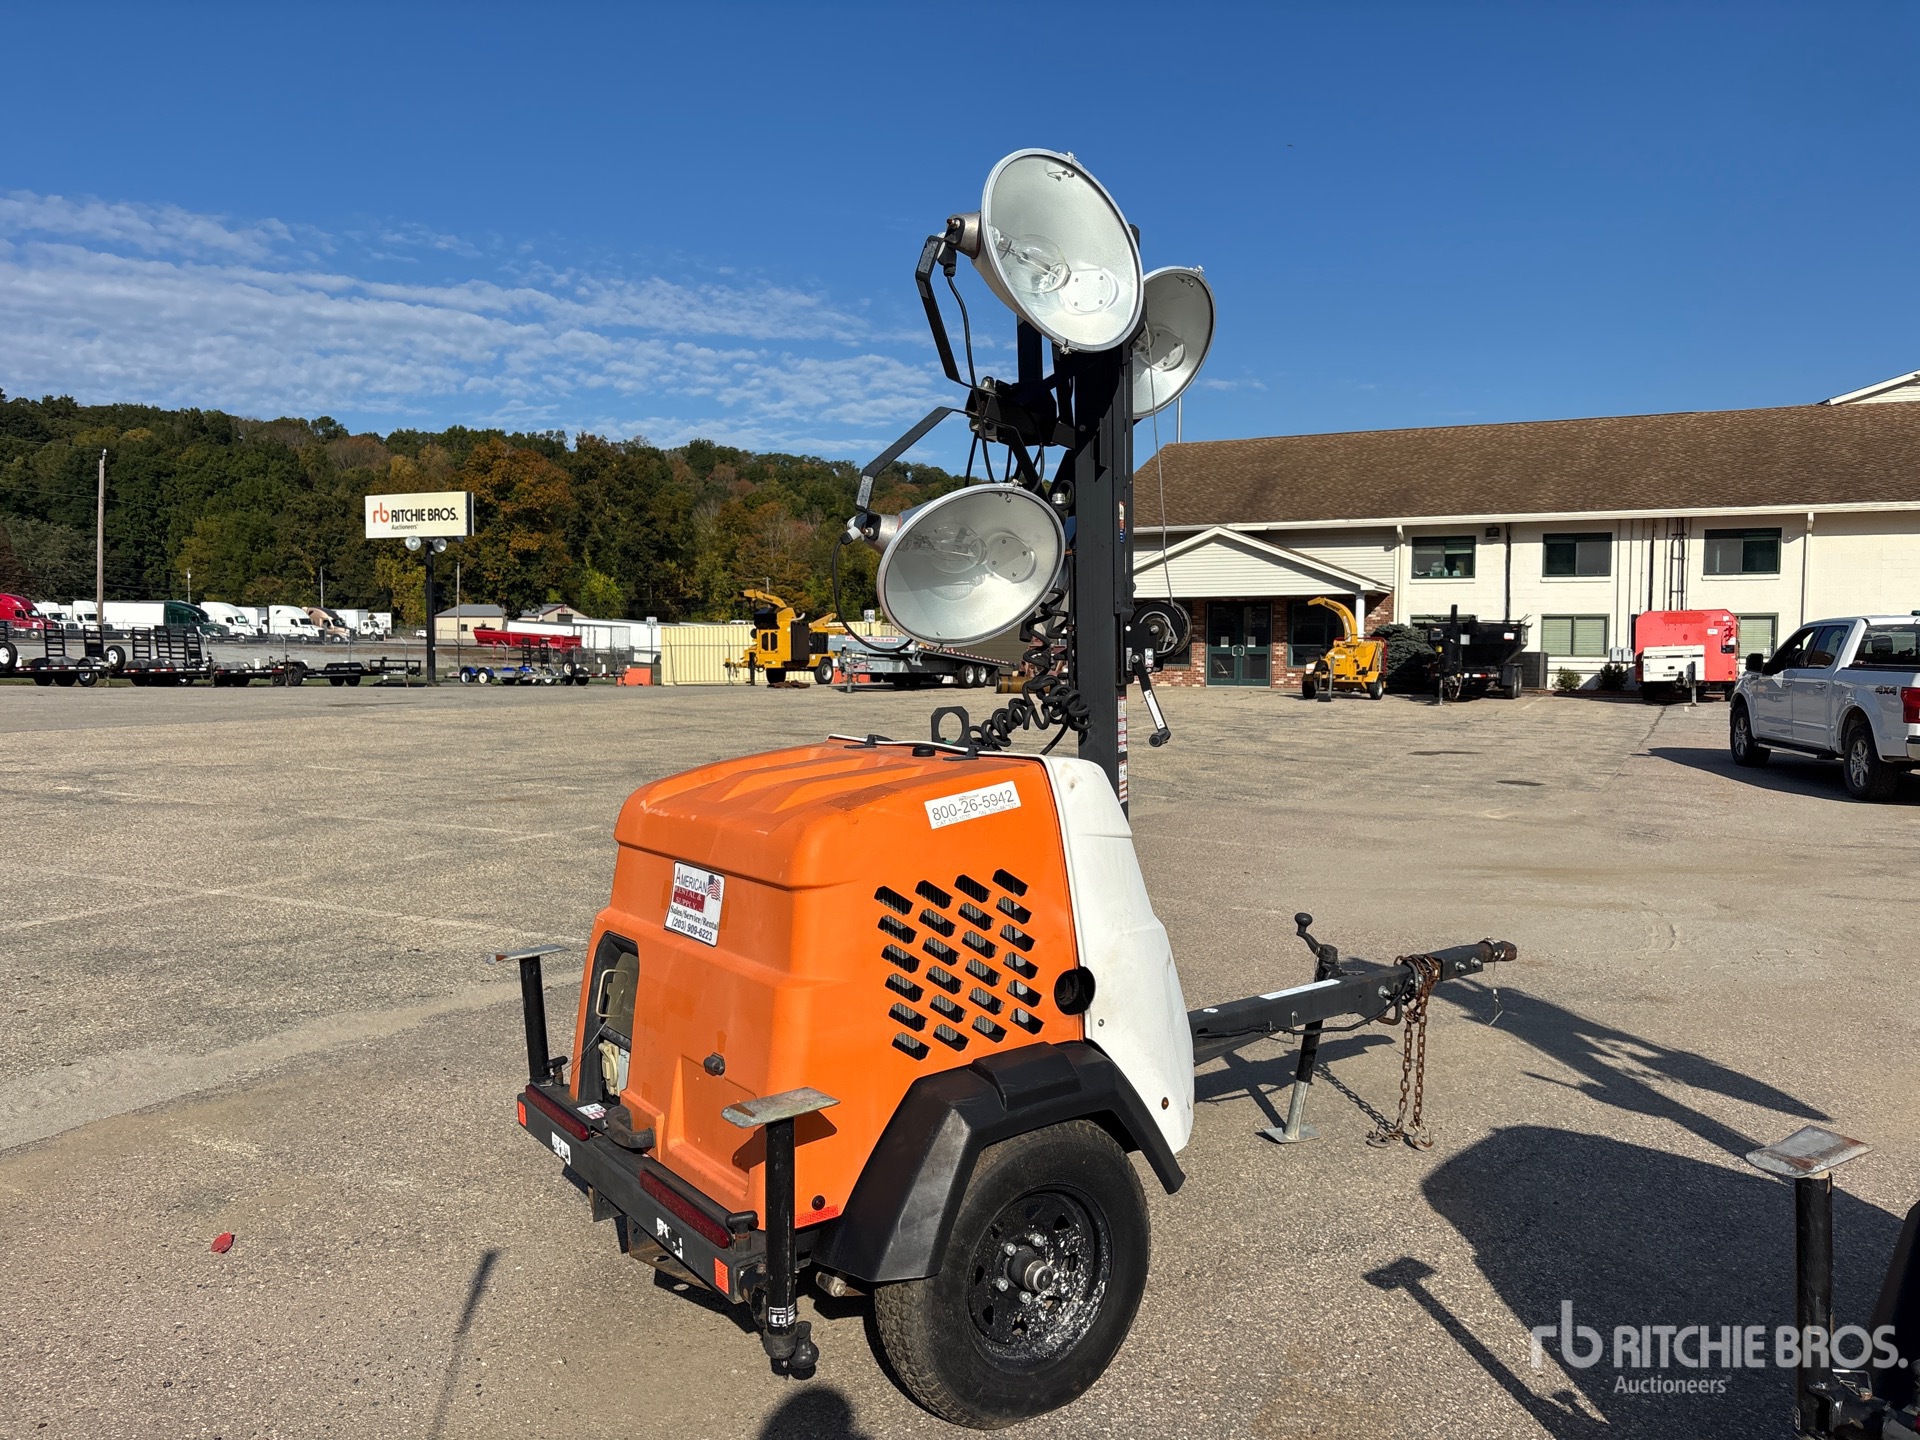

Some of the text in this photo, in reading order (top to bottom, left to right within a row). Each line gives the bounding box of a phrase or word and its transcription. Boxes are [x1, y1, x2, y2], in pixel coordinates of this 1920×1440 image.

[373, 502, 459, 523] rb RITCHIE BROS.
[932, 790, 1014, 820] 800-26-5942
[675, 867, 708, 893] AMERICAN
[671, 916, 713, 941] (203) 909-6223
